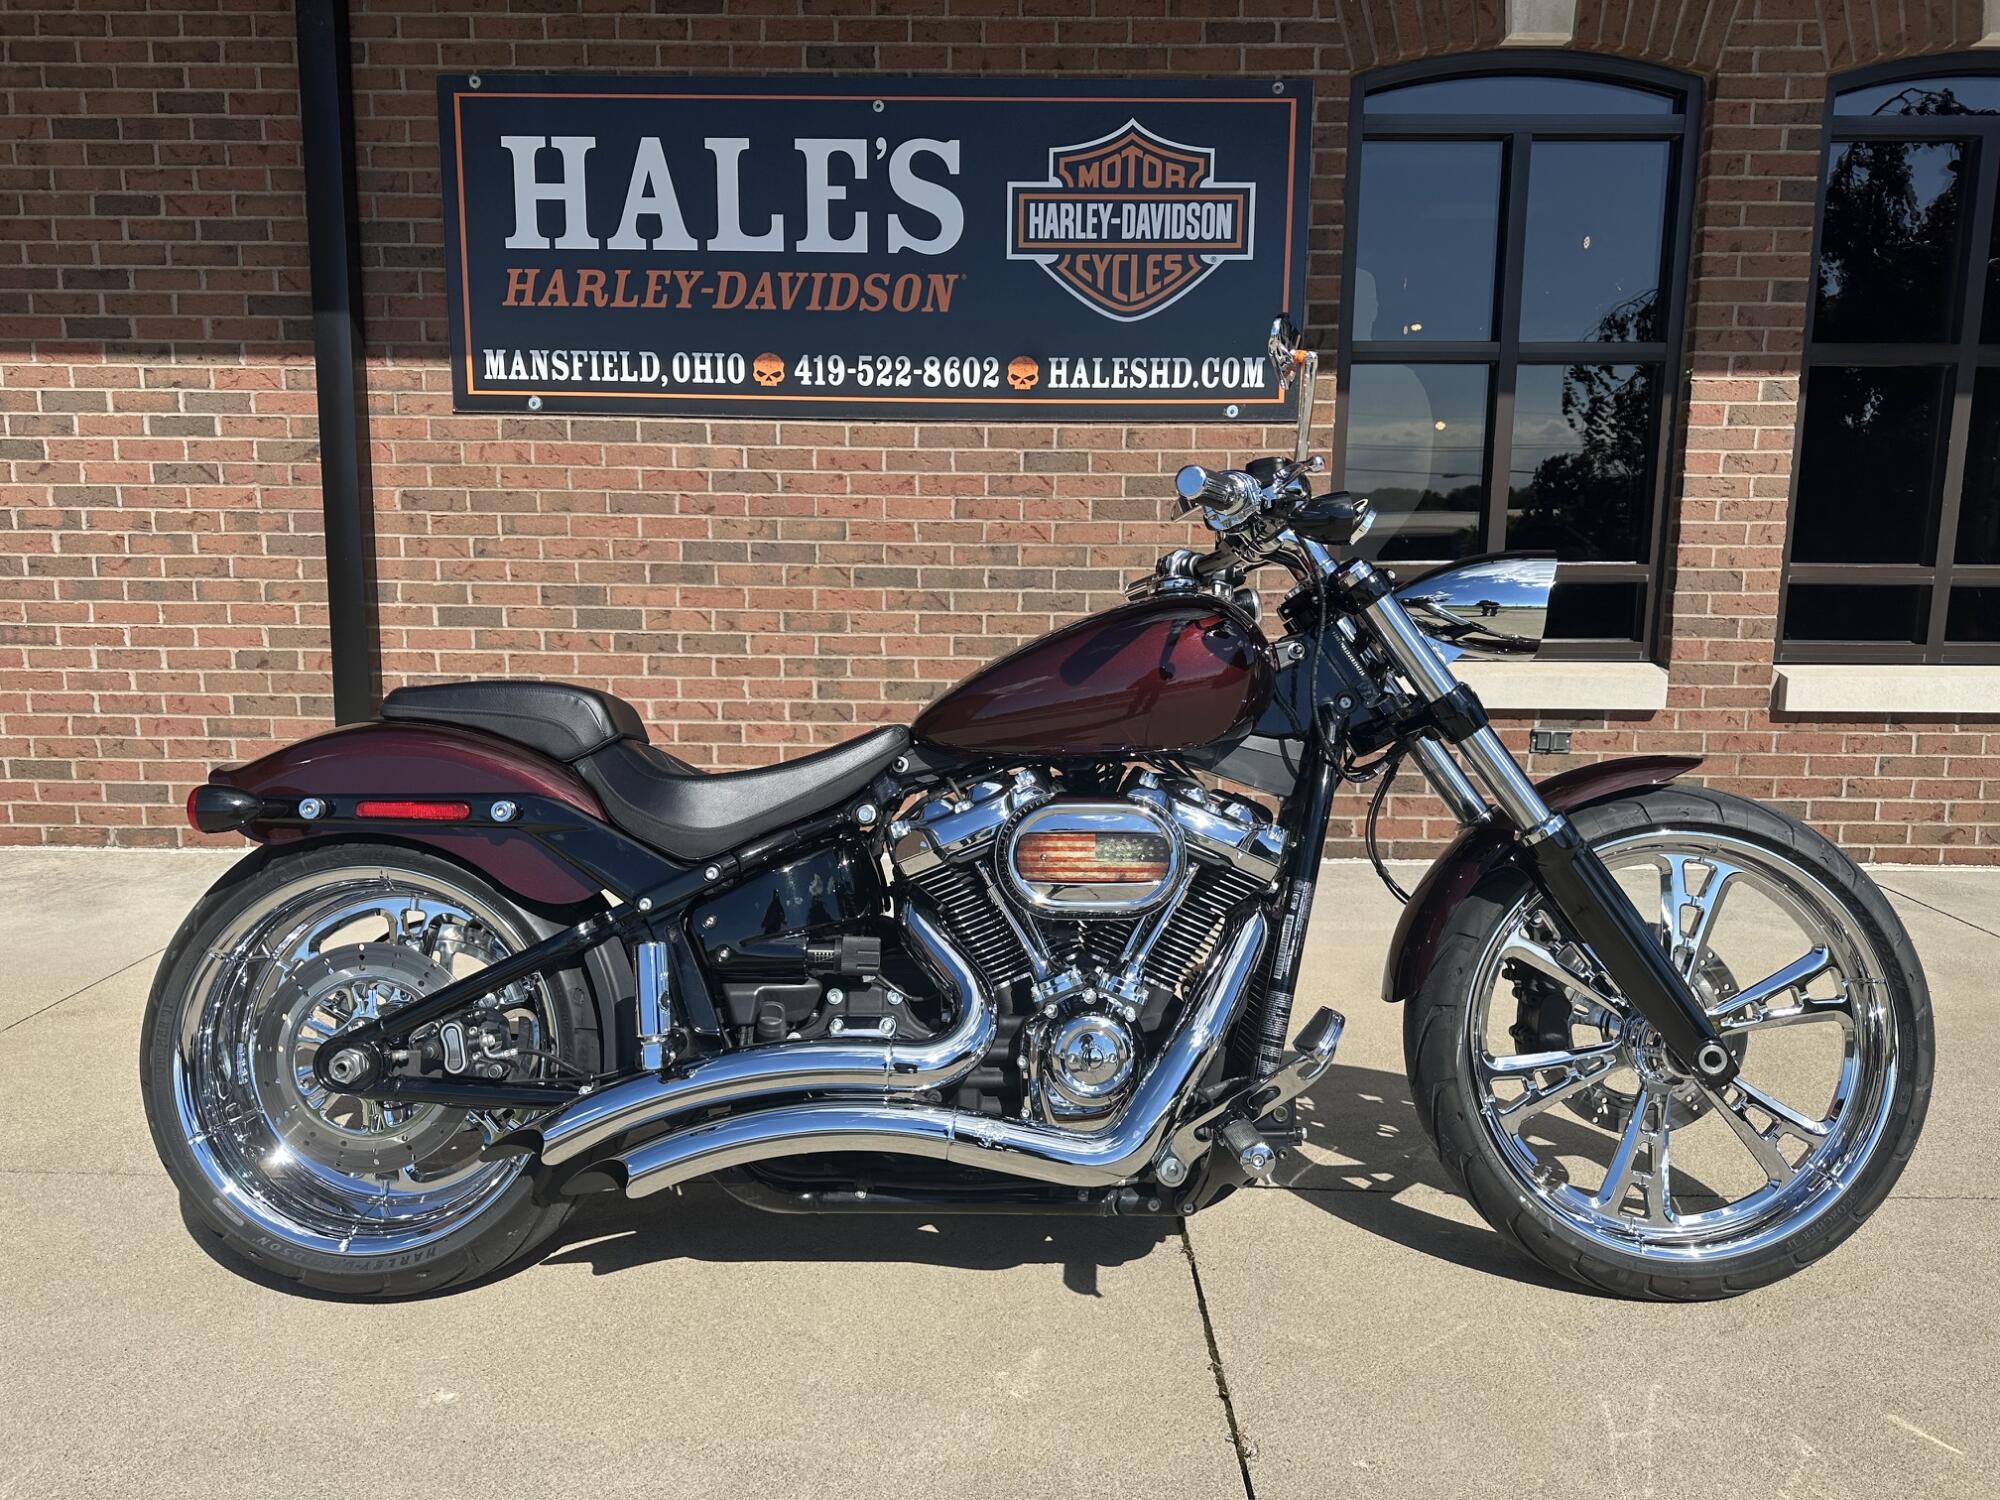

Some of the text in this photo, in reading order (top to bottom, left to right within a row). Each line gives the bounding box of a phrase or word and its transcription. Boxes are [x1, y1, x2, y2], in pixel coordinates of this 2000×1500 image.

[1078, 145, 1187, 189] MOTOR
[500, 135, 964, 255] HALE'S
[1028, 201, 1234, 241] HARLEY-DAVIDSON
[502, 267, 959, 313] HARLEY-DAVIDSON
[1075, 254, 1184, 303] CYCLES
[794, 353, 1000, 389] 419-522-8602
[1047, 357, 1266, 389] HALESHD.COM
[256, 1235, 437, 1274] HARLEY-DIDSON
